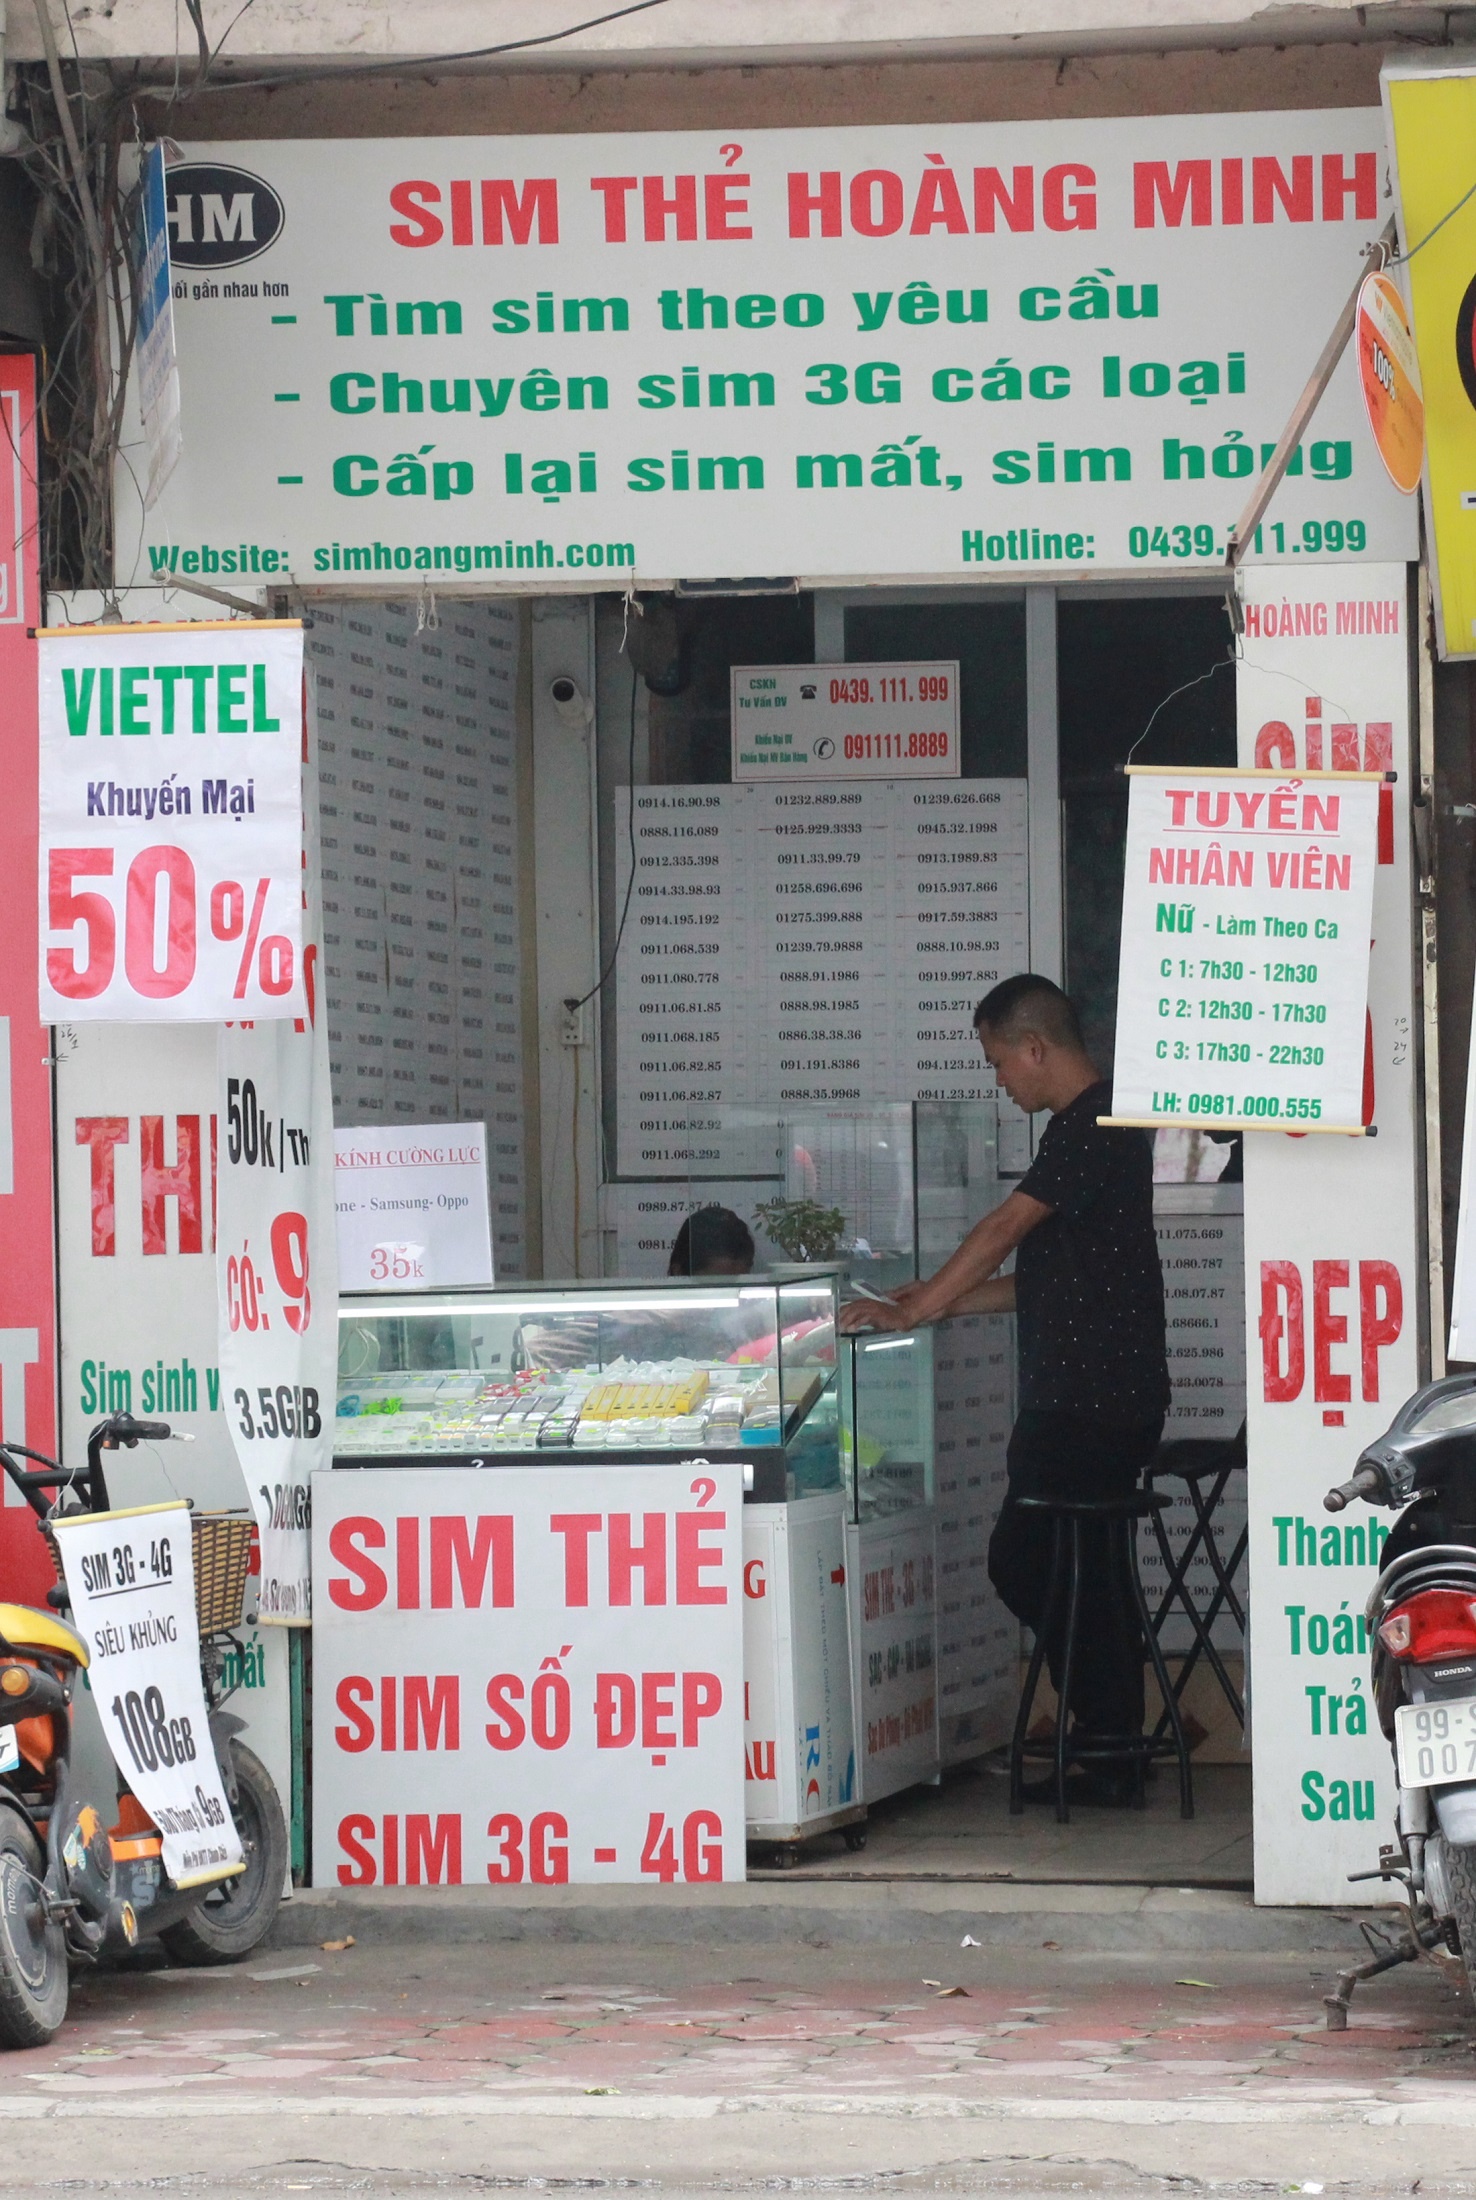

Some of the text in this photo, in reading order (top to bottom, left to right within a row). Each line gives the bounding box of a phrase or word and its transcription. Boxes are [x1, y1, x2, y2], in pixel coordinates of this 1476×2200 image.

[389, 143, 1377, 248] SIM THẺ HOÀNG MINH
[192, 278, 218, 300] gần
[223, 282, 258, 299] nhau
[263, 281, 289, 298] hơn
[324, 293, 462, 337] Tìm
[492, 291, 629, 334] sim
[658, 288, 824, 330] theo
[852, 280, 988, 331] yêu
[1018, 267, 1159, 321] cầu
[330, 367, 609, 418] Chuyên
[637, 366, 774, 410] sim
[804, 361, 901, 405] 3G
[931, 358, 1071, 402] các
[1103, 352, 1246, 405] loại
[332, 444, 474, 501] Cấp
[505, 451, 597, 503] lại
[627, 450, 764, 493] sim
[797, 435, 963, 491] mất,
[992, 442, 1131, 485] sim
[148, 539, 635, 574] Website: simhoangminh.com
[962, 529, 1095, 563] Hotline:
[1245, 597, 1400, 637] HOÀNG MINH
[61, 663, 280, 737] VIETTEL
[829, 676, 948, 704] 0439. 111. 999
[843, 732, 948, 760] 091111.8889
[87, 772, 255, 823] Khuyến Mại
[638, 796, 720, 808] 0914.16.90.98
[775, 794, 862, 806] 01232.889.889
[913, 792, 1001, 805] 01239.626.668
[1163, 778, 1341, 832] TUYỂN
[640, 826, 719, 838] 0888.116.089
[917, 822, 997, 834] 0945.32.1998
[640, 855, 719, 867] 0912.335.398
[777, 852, 860, 865] 0911.33.99.79
[917, 852, 998, 864] 0913.1989.83
[1149, 843, 1352, 892] NHÂN VIÊN
[638, 884, 720, 896] 0914.33.98.93
[776, 882, 862, 894] 01258.696.696
[917, 881, 998, 894] 0915.937.866
[46, 845, 294, 1000] 50%
[640, 914, 719, 926] 0914.195.192
[776, 911, 862, 924] 01275.399.888
[917, 911, 998, 923] 0917.59.3883
[1155, 902, 1339, 940] Nữ Làm Theo Ca
[640, 943, 719, 955] 0911.068.539
[776, 941, 863, 953] 01239.79.9888
[916, 941, 1000, 953] 0888.10.98.93
[640, 973, 719, 984] 0911.080.778
[780, 970, 860, 982] 0888.91.1986
[918, 970, 998, 982] 0919.997.883
[1160, 958, 1318, 984] C 1: 7h30 12h30
[639, 1002, 721, 1014] 0911.06.81.85
[780, 1000, 860, 1012] 0888.98.1985
[1158, 998, 1327, 1025] C 2: 12h30 17h30
[641, 1031, 720, 1043] 0911.068.185
[778, 1029, 862, 1041] 0886.38.38.36
[780, 1059, 860, 1071] 091.191.8386
[1155, 1040, 1324, 1067] C 3: 17h30 22h30
[639, 1060, 721, 1073] 0911.06.82.85
[639, 1090, 722, 1102] 0911.06.82.87
[780, 1088, 860, 1101] 0888.35.9968
[1151, 1091, 1322, 1120] LH: 0981.000.555
[334, 1145, 480, 1167] KÍNH CƯỜNG LỰC
[75, 1114, 217, 1257] TH
[437, 1193, 469, 1210] Oppo
[370, 1247, 424, 1280] 35k
[1258, 1259, 1403, 1428] ĐẸP
[80, 1357, 197, 1416] Sim sinh
[327, 1514, 515, 1612] SIM
[550, 1477, 728, 1607] THẺ
[1272, 1515, 1389, 1567] Thanh
[81, 1551, 112, 1593] SIM
[113, 1544, 135, 1587] 3G
[151, 1537, 173, 1578] 4G
[95, 1610, 177, 1658] SIÊU KHỦNG
[1433, 1666, 1473, 1678] HONDA
[334, 1675, 460, 1753] SIM
[485, 1644, 574, 1752] SỐ
[593, 1671, 723, 1766] ĐẸP
[1304, 1677, 1367, 1736] Trả
[112, 1685, 197, 1775] 108GB
[1300, 1770, 1376, 1822] Sau
[337, 1813, 462, 1887] SIM
[486, 1811, 570, 1887] 3G
[640, 1809, 723, 1884] 4G
